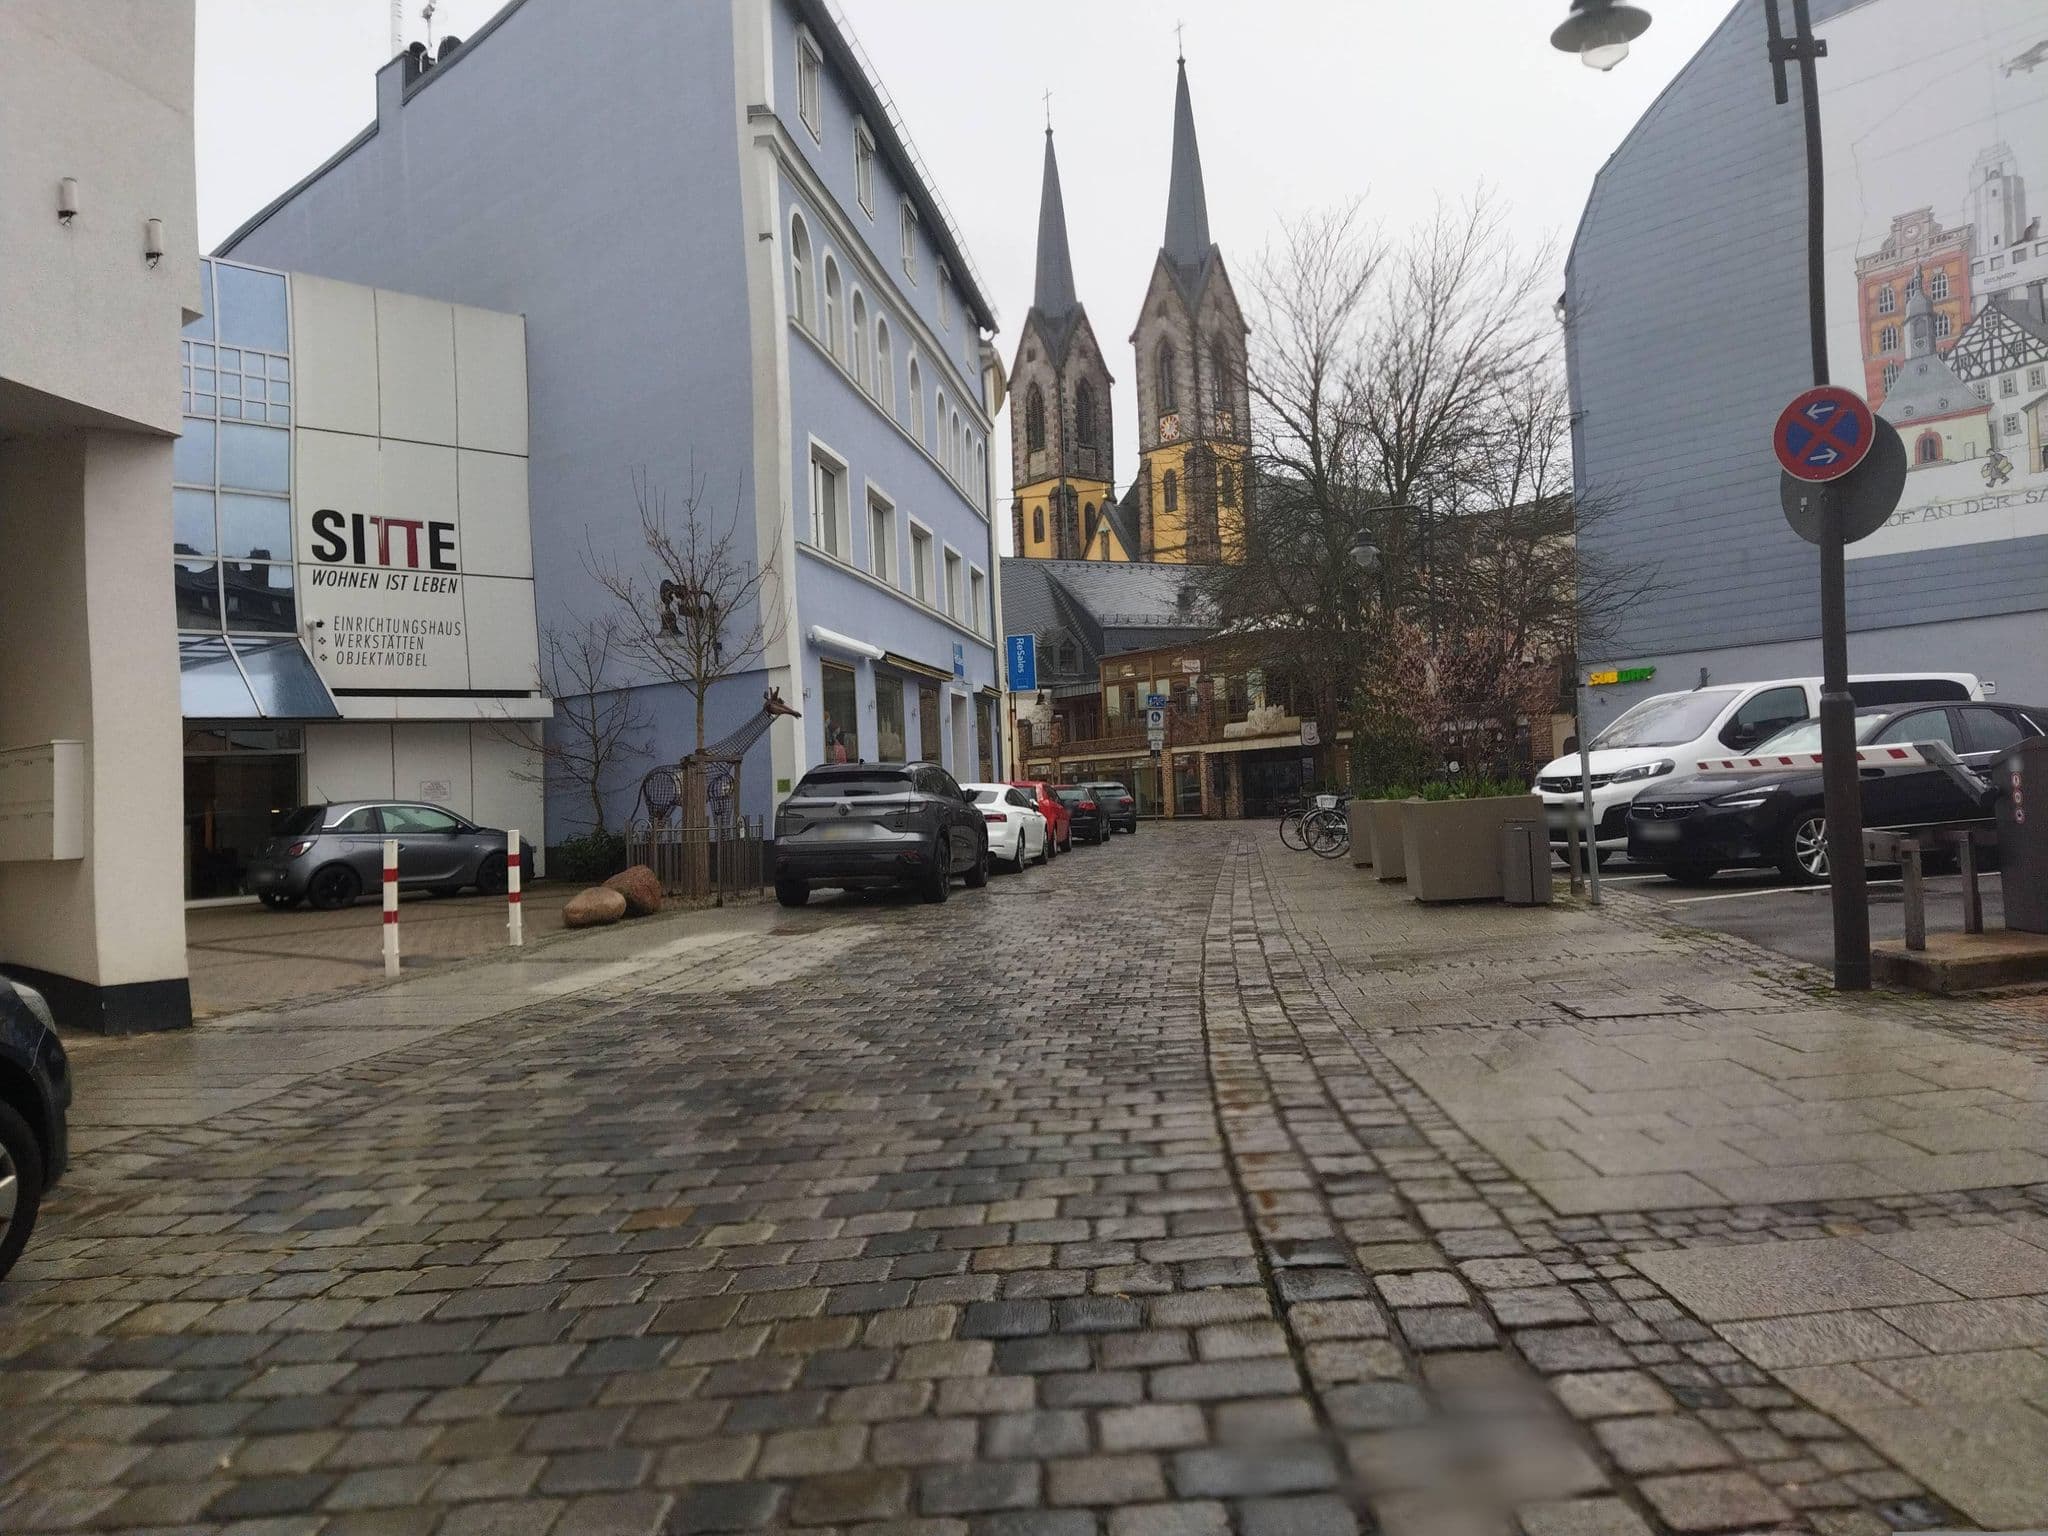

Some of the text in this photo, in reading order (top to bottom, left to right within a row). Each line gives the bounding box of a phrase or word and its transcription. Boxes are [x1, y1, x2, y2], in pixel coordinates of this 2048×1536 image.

[1882, 511, 1915, 527] OF
[1922, 504, 1952, 522] AN
[1964, 494, 2011, 515] DER
[311, 509, 457, 571] SITTE
[312, 569, 458, 594] WOHNEN IST LEBEN
[334, 615, 461, 636] EINRICHTUNGSHAUS
[334, 633, 424, 650] WERKSTÄTTEN
[336, 651, 427, 666] OBJEKTMÖBEL
